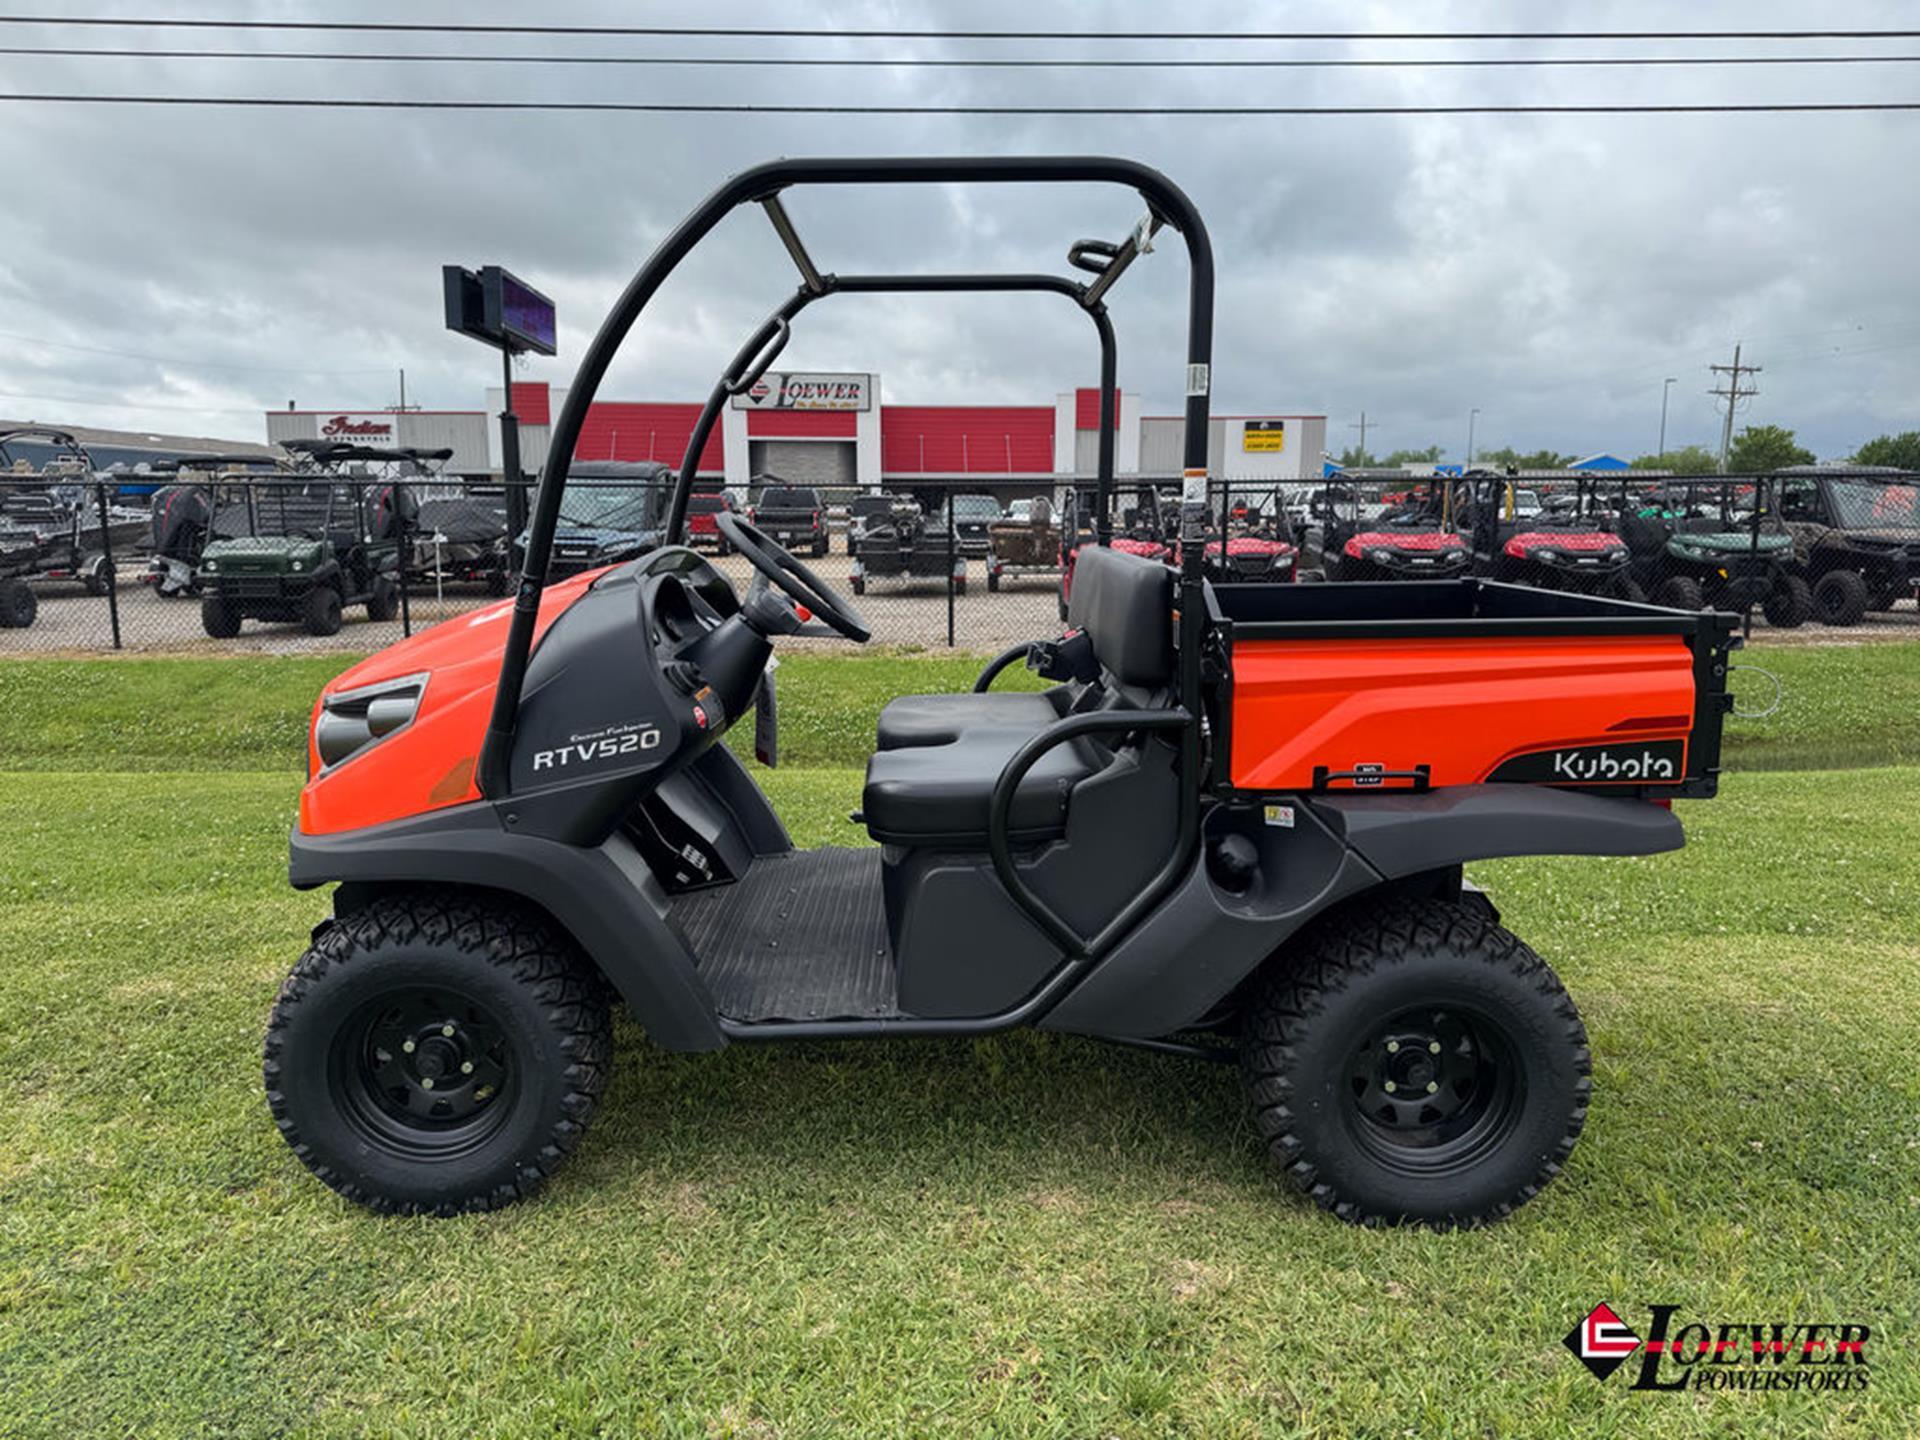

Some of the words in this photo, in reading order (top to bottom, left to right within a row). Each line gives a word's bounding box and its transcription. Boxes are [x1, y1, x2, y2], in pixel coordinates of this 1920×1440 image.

[775, 374, 861, 408] LOEWER
[322, 416, 391, 435] Indian
[533, 730, 660, 770] RTV520
[1555, 751, 1673, 779] Kubota
